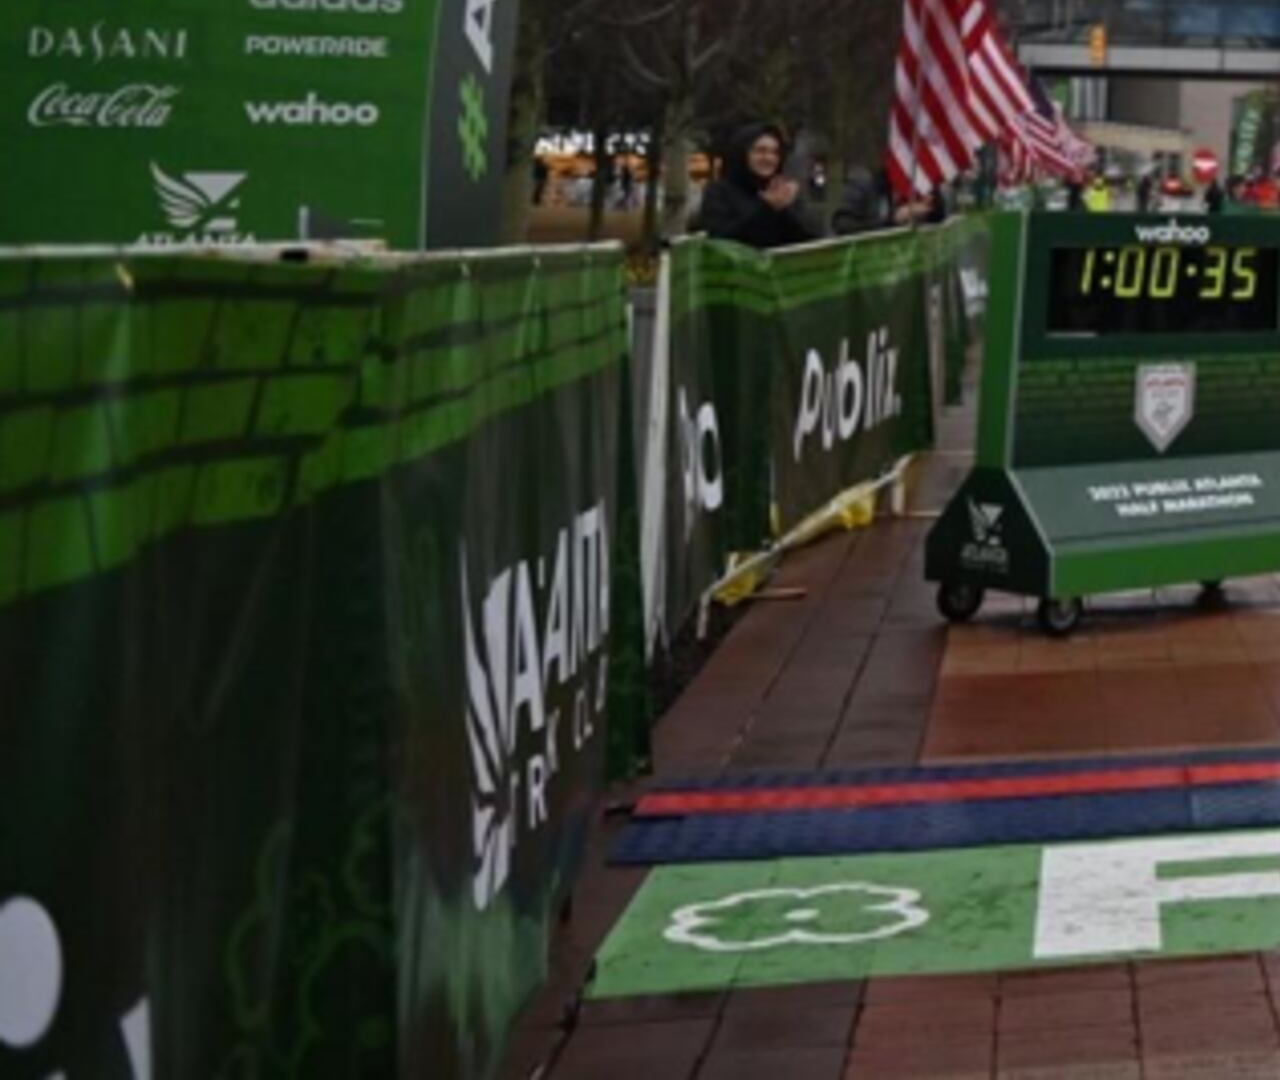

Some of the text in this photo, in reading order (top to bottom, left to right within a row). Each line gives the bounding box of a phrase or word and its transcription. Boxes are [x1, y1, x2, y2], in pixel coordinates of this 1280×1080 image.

[27, 21, 188, 65] DASANI
[245, 35, 389, 58] POWERADE
[244, 92, 379, 126] wahoo
[1133, 218, 1210, 243] wahoo
